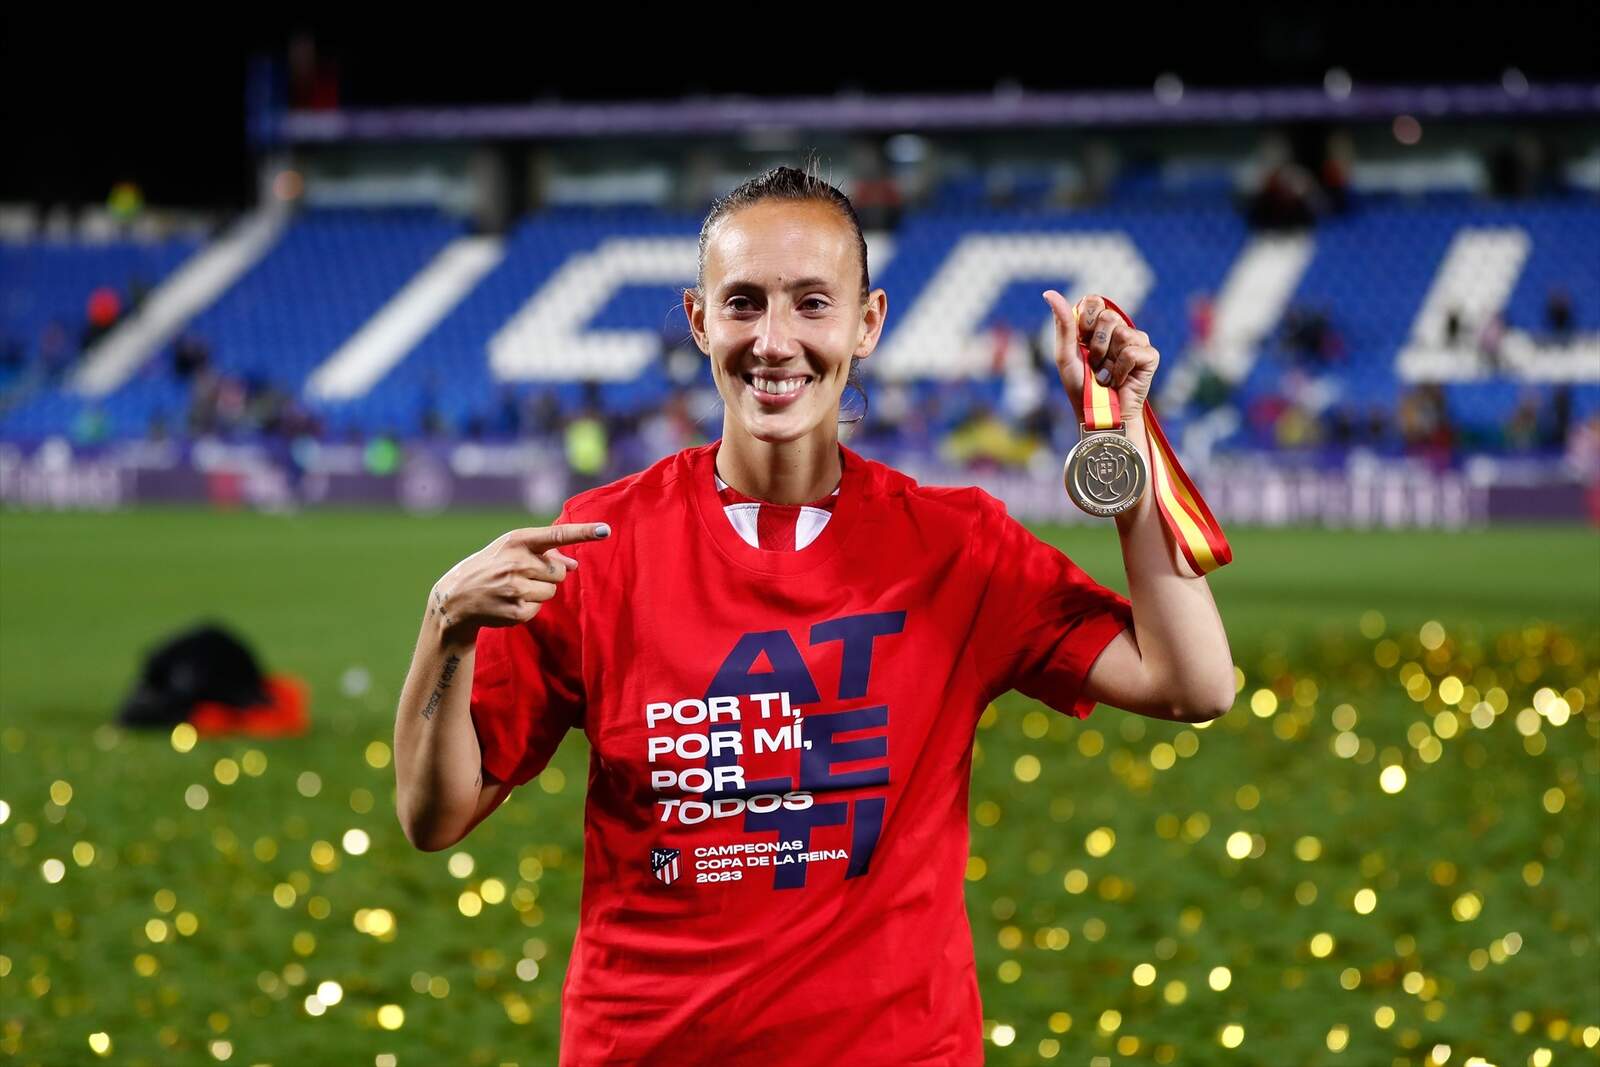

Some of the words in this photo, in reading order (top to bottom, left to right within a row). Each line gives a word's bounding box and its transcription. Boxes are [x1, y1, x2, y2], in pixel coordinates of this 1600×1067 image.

[646, 696, 741, 729] POR
[750, 692, 801, 719] TI,
[648, 731, 743, 762] POR
[753, 717, 813, 754] MÍ,
[652, 765, 746, 793] POR
[658, 791, 814, 825] TODOS
[694, 840, 804, 858] CAMPEONAS
[695, 856, 744, 871] COPA
[747, 855, 770, 867] DE
[773, 853, 796, 866] LA
[798, 849, 849, 864] REINA
[696, 871, 743, 884] 2023
